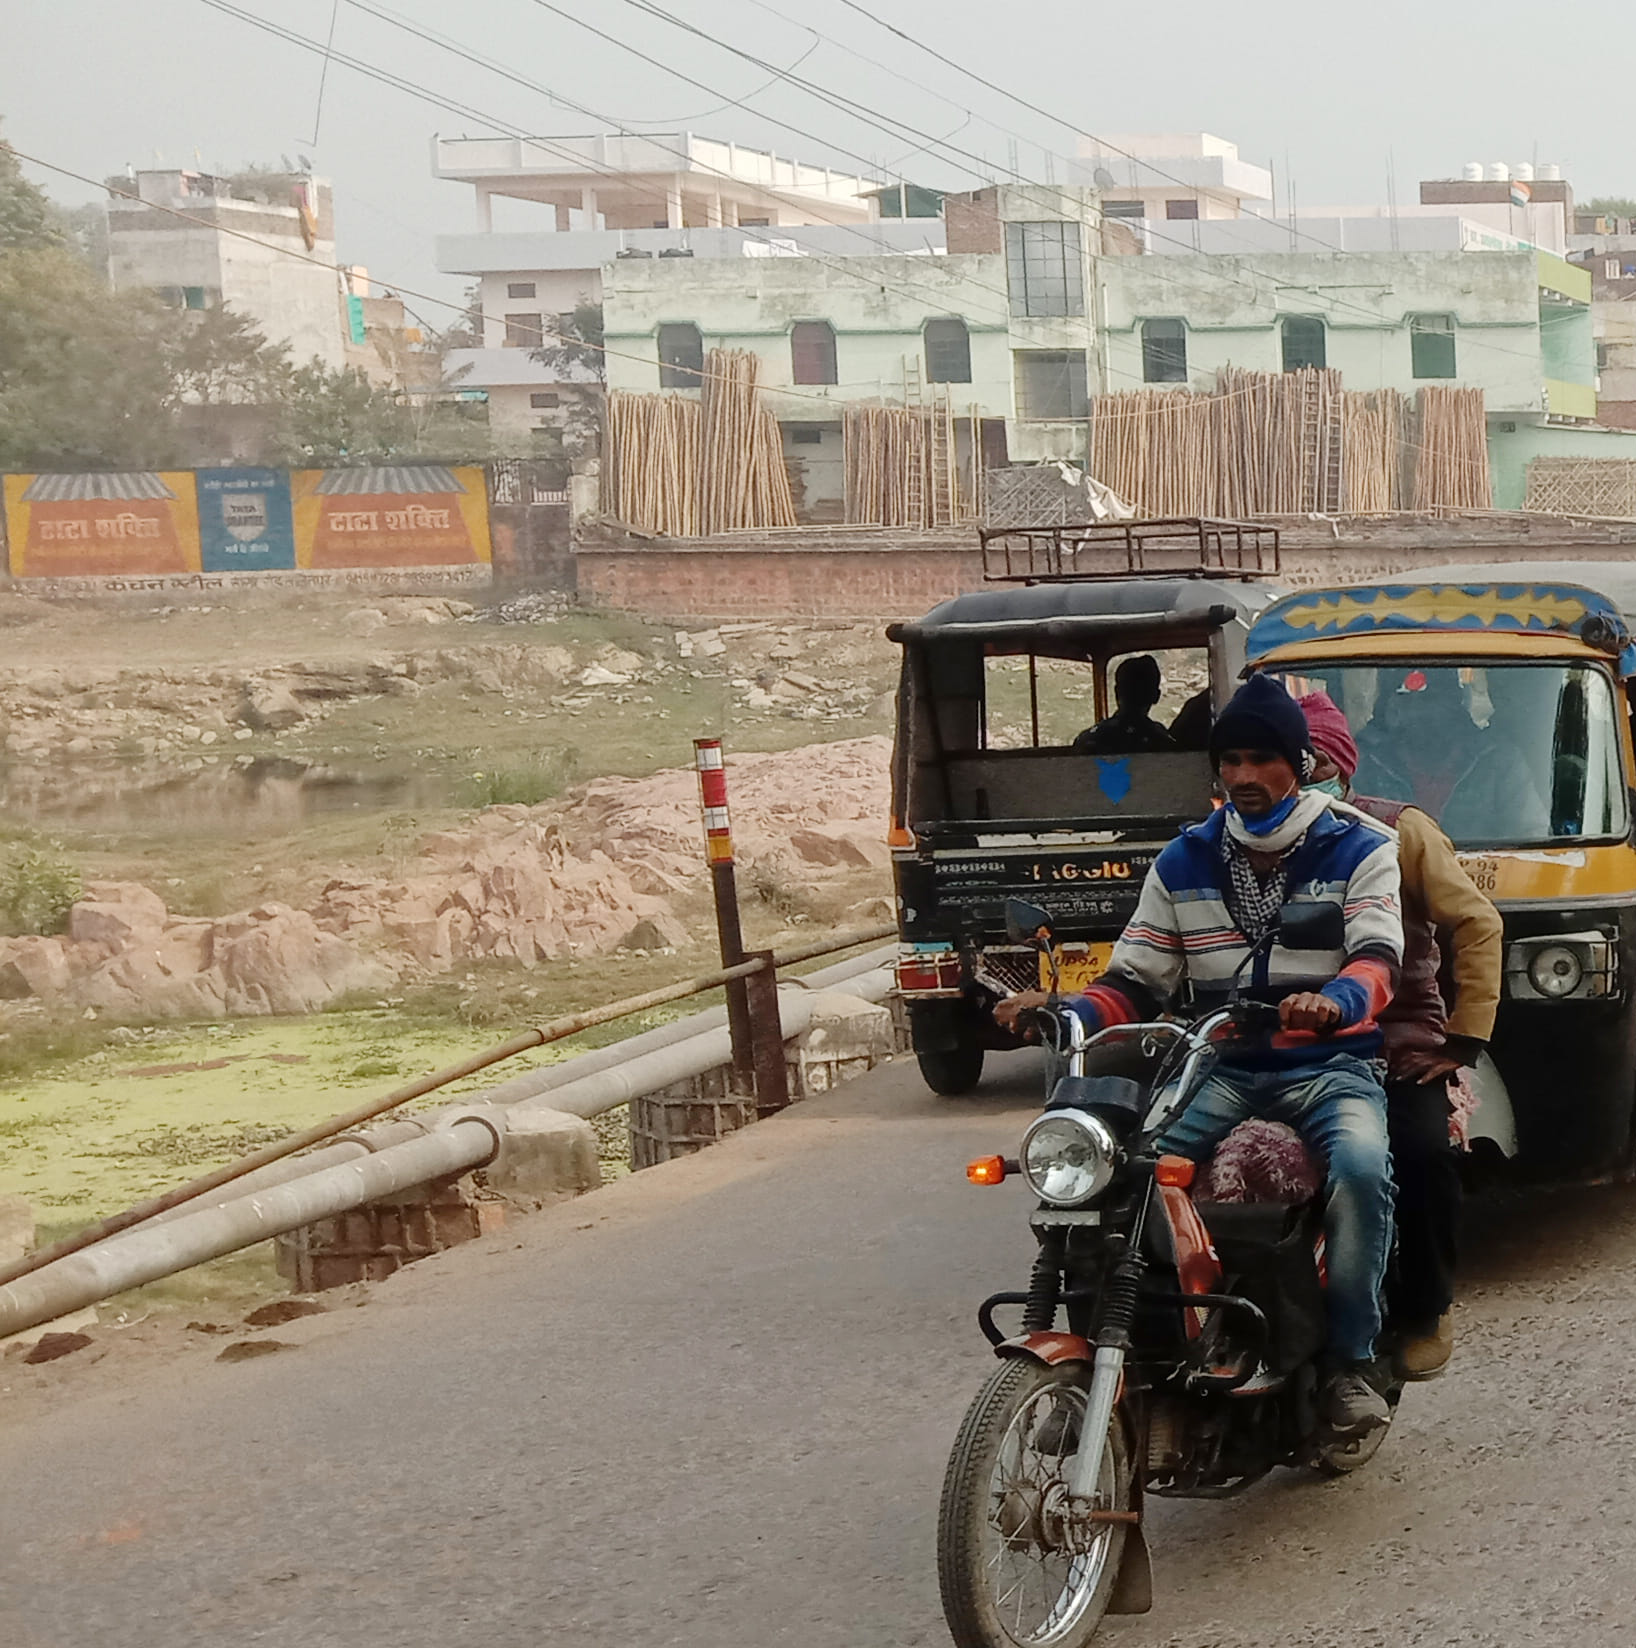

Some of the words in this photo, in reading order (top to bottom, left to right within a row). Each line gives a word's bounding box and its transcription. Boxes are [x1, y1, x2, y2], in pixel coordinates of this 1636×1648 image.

[38, 519, 91, 541] टाटा
[95, 513, 160, 539] शक्ति
[328, 511, 379, 532] टाटा
[384, 504, 450, 531] शक्ति
